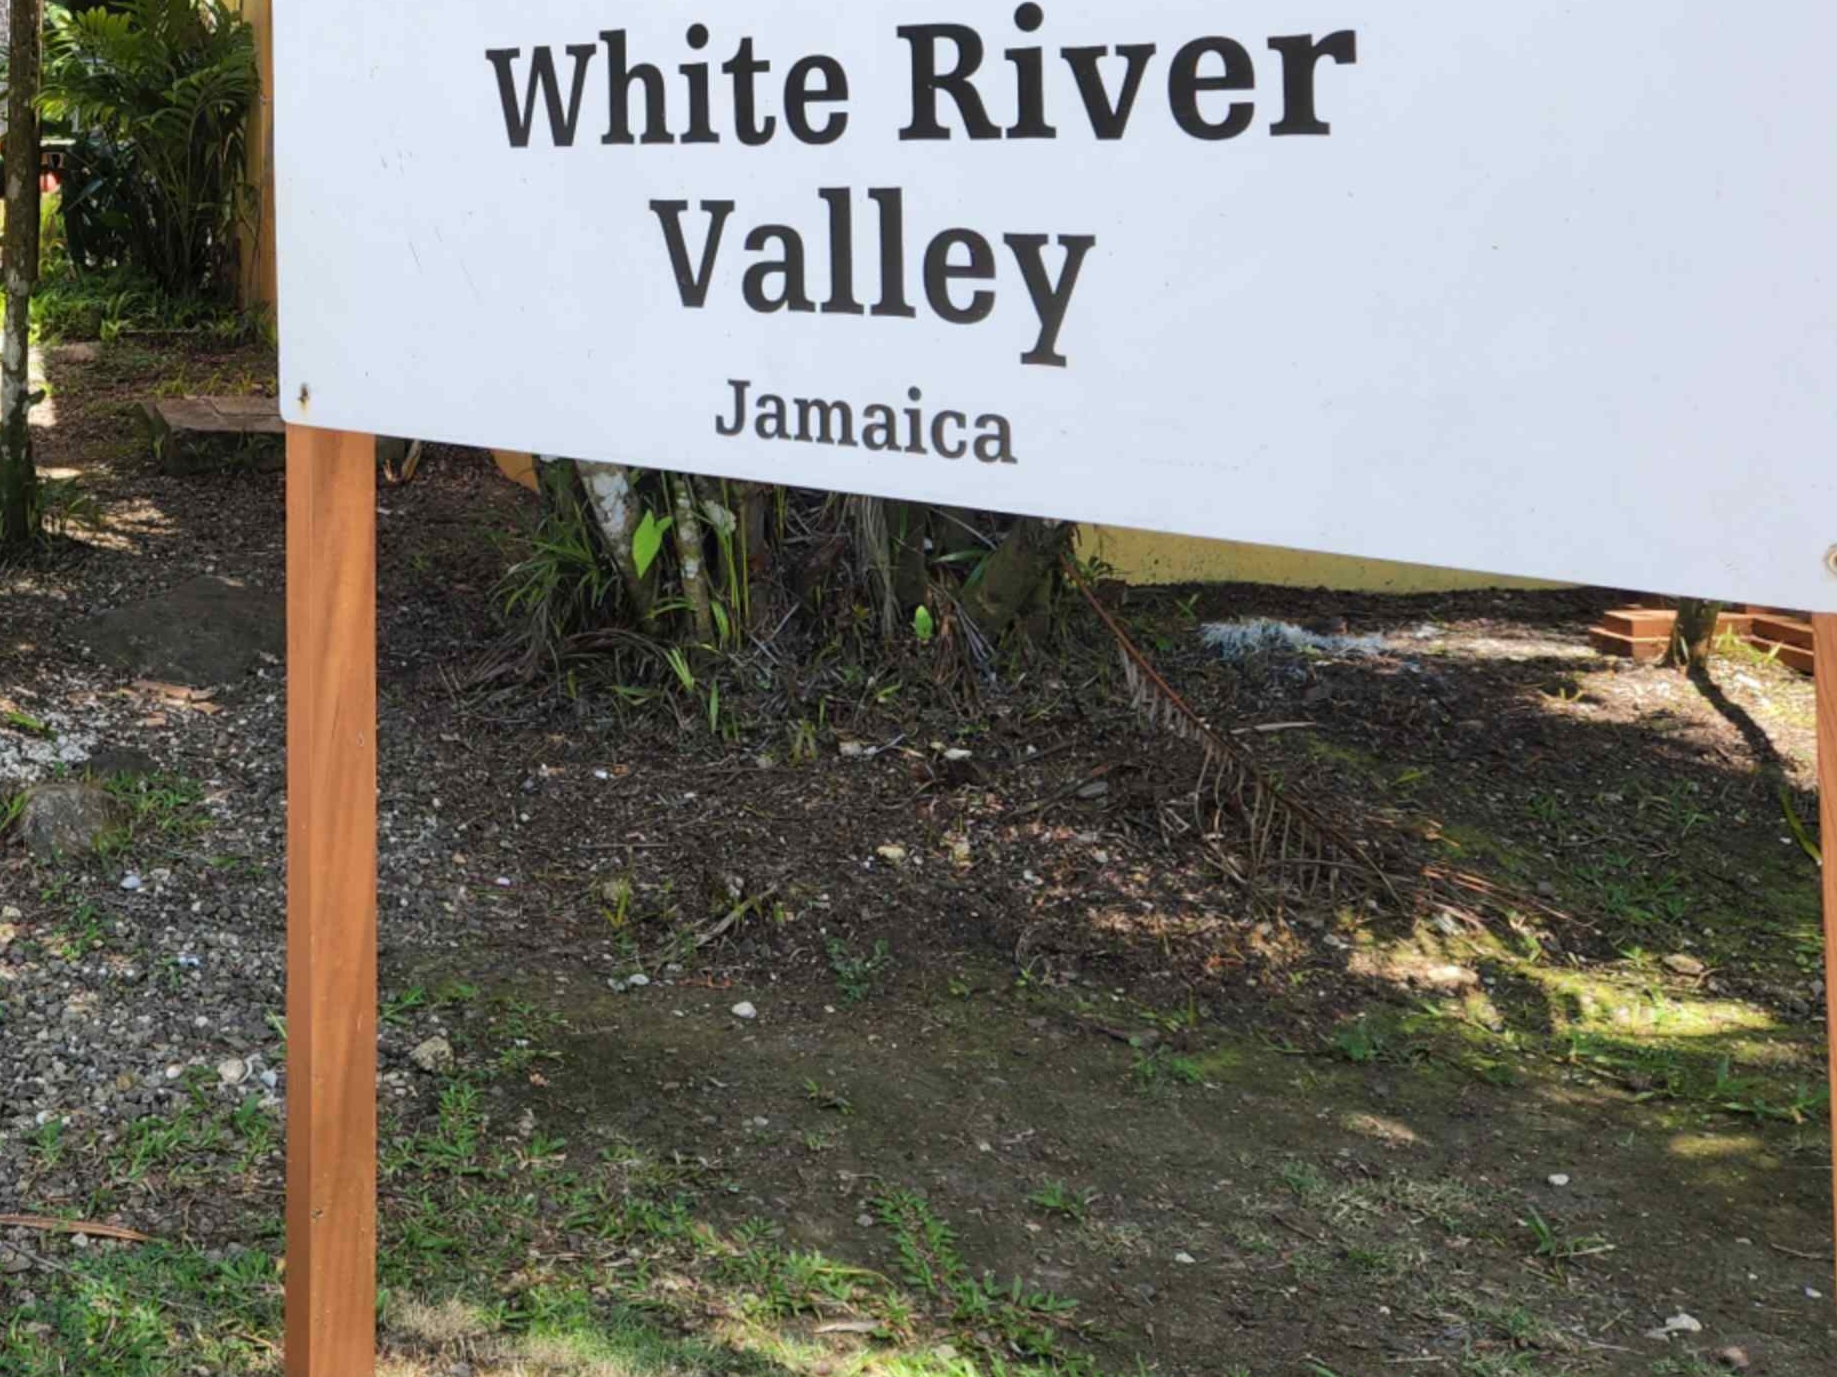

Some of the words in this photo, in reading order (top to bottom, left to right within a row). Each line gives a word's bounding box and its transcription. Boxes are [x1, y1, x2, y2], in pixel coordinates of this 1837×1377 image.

[486, 23, 849, 148] White
[897, 2, 1357, 142] River
[649, 187, 1096, 368] Valley
[716, 379, 1018, 465] Jamaica
